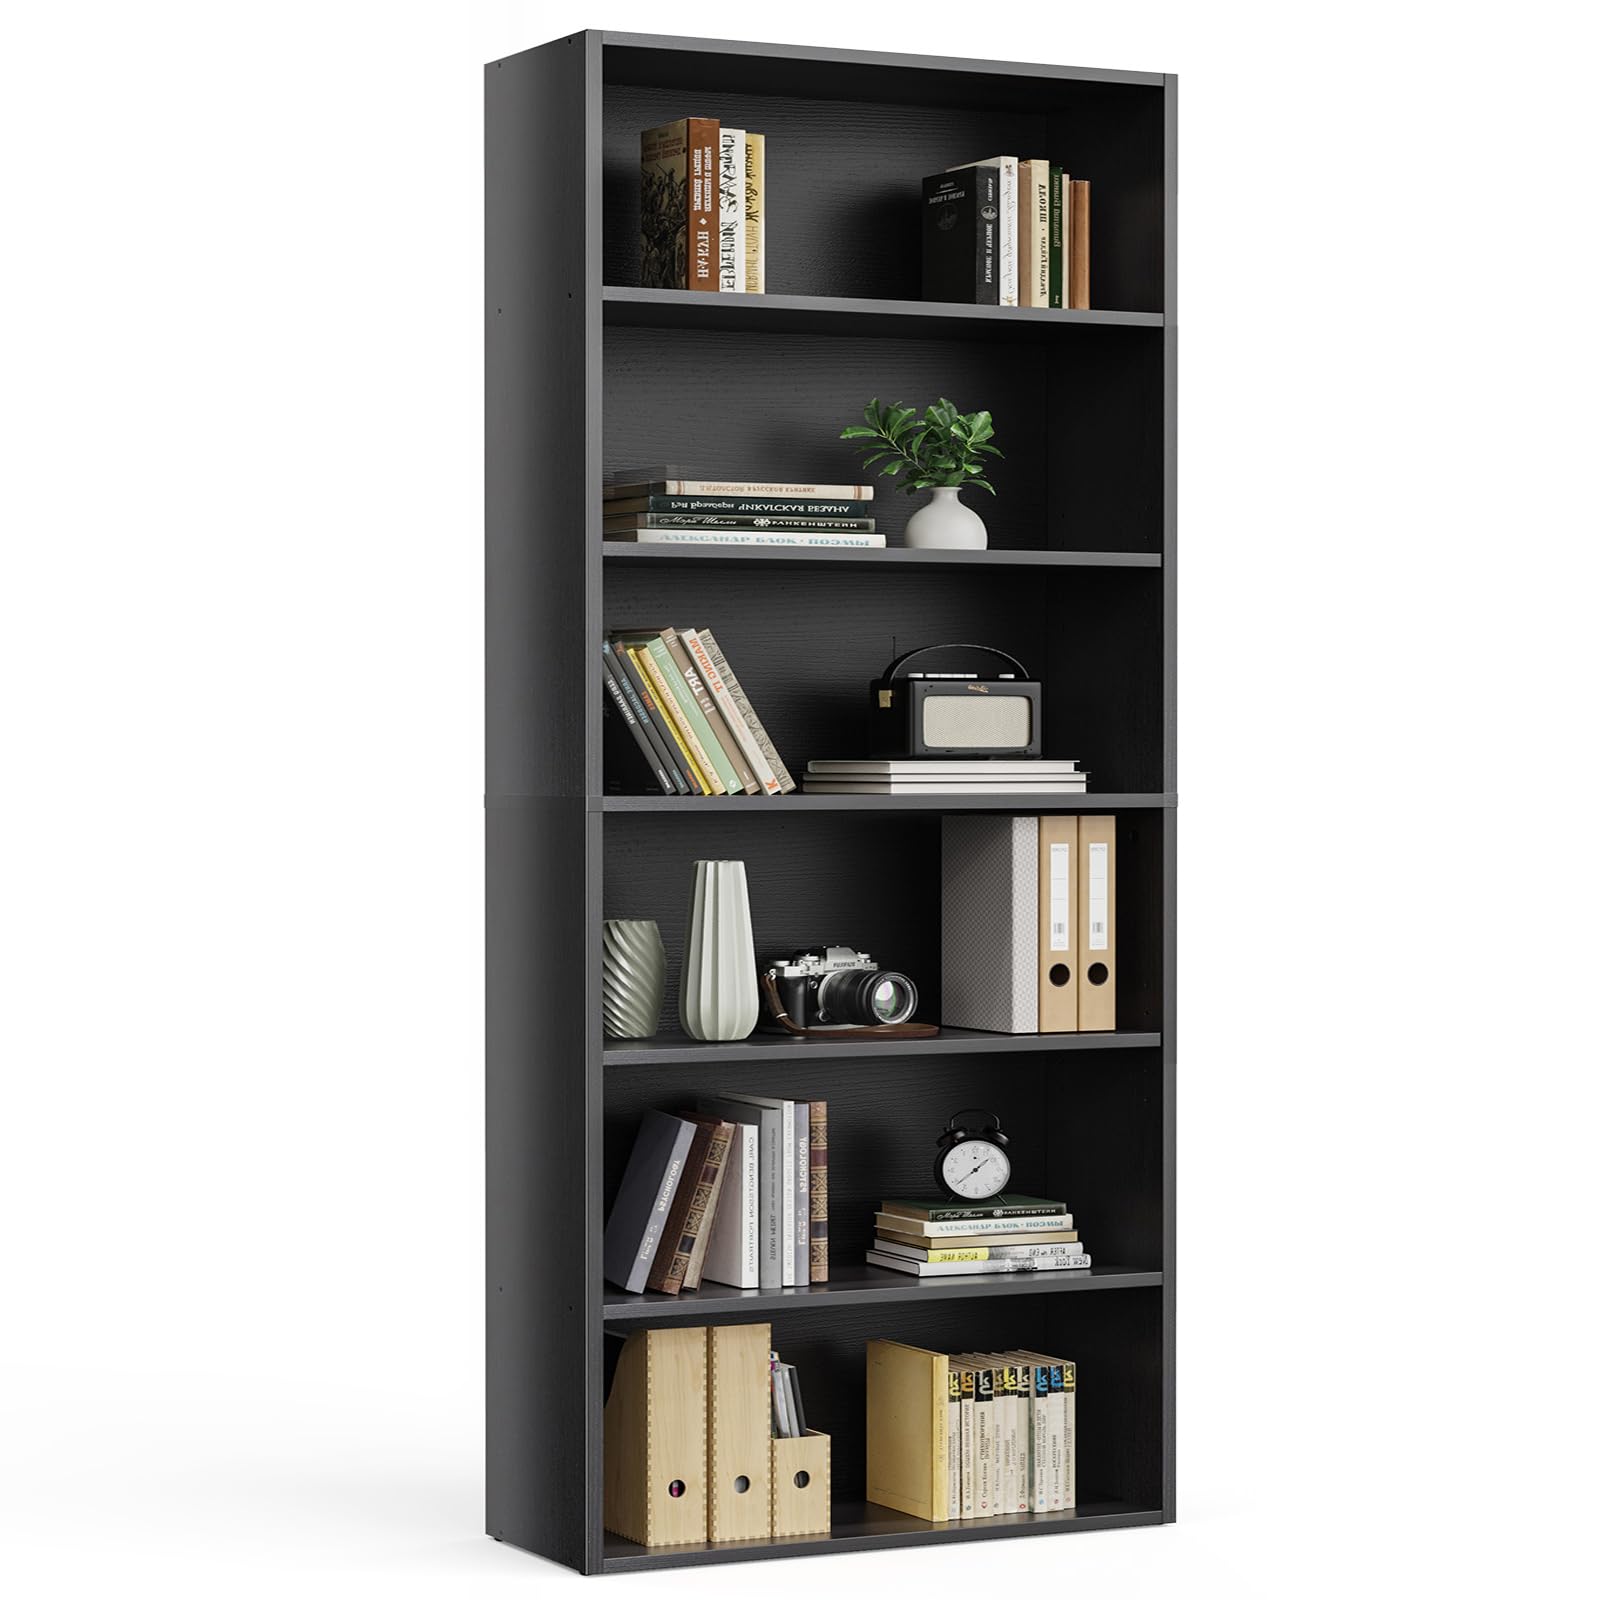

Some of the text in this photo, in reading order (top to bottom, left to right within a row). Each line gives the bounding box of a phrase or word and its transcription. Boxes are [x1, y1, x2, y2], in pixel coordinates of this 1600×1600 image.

[755, 536, 797, 545] БЛОК
[807, 538, 870, 547] ПОЭМЫ
[994, 1221, 1020, 1230] БЛОК
[1025, 1220, 1064, 1229] ПОЭМЫ
